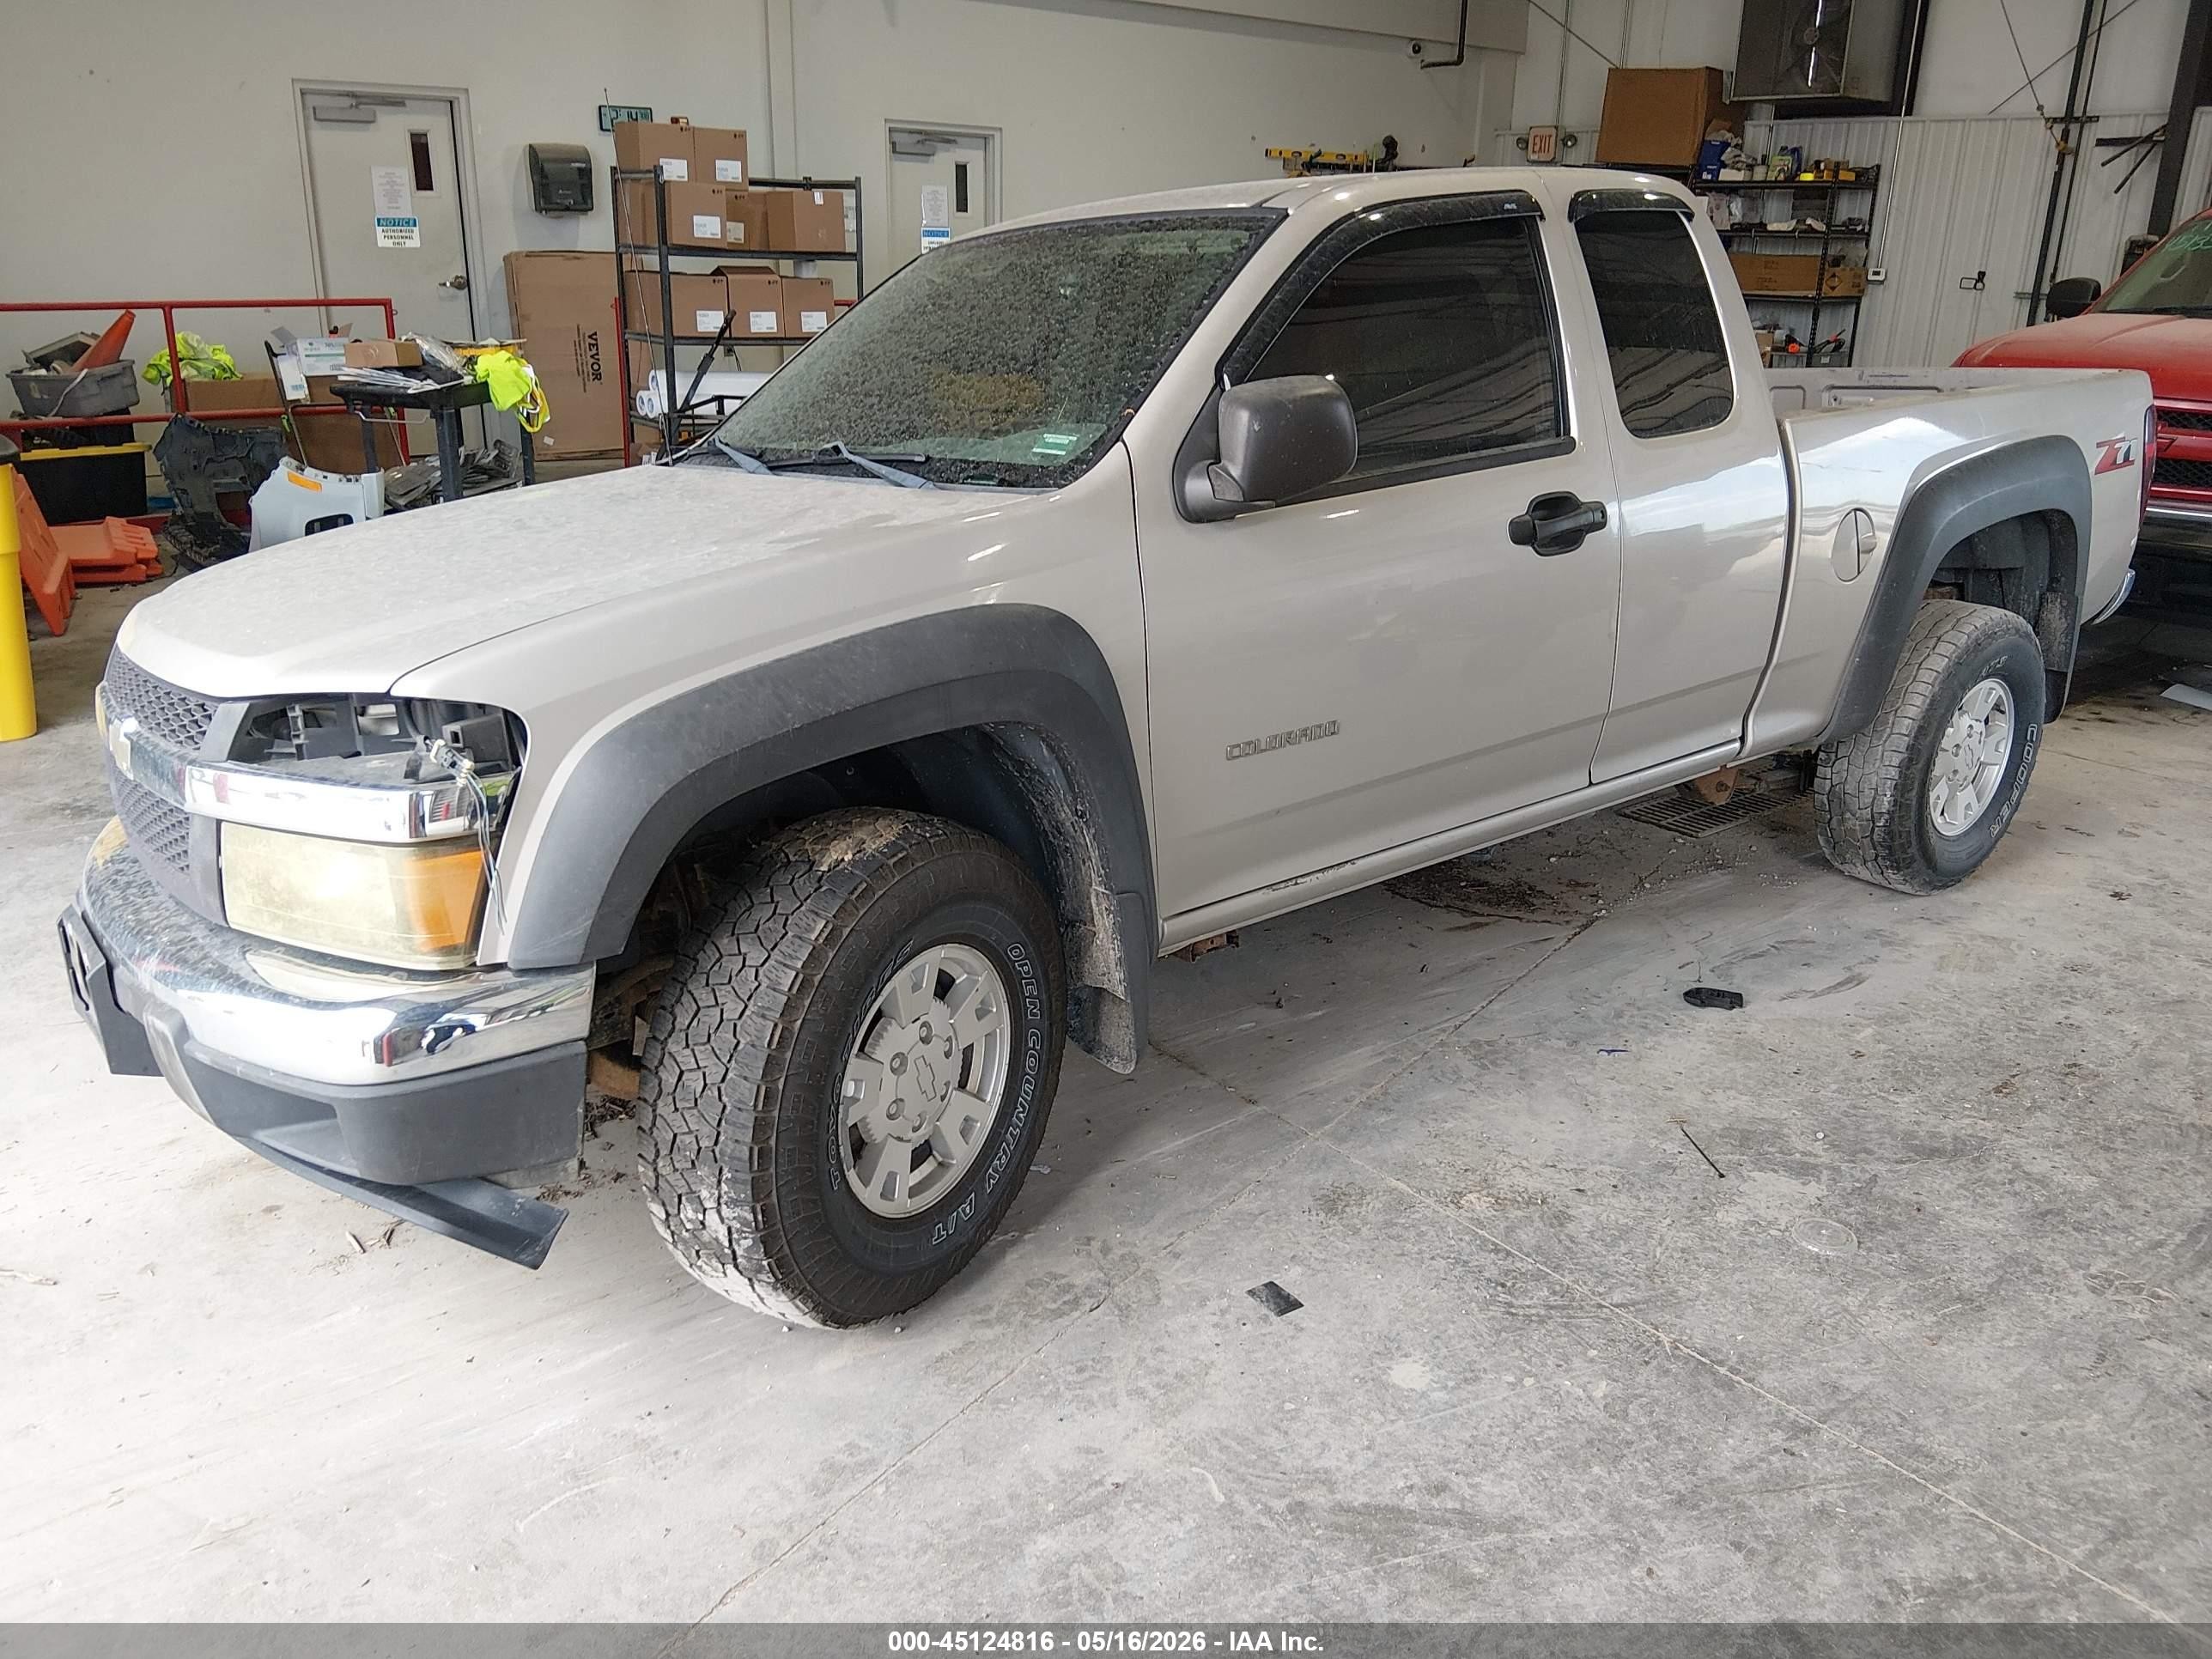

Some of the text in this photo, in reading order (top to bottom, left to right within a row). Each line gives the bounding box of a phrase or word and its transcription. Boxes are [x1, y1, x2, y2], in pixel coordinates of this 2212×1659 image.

[1532, 134, 1553, 154] EXIT
[380, 218, 415, 227] NOTICE
[587, 331, 603, 382] VEVOR
[2094, 436, 2138, 475] Z71
[1225, 720, 1340, 761] COLORADO
[1990, 723, 2038, 839] COOPER
[932, 943, 1042, 1245] OPEN COUNTRY A/T
[829, 1073, 842, 1190] TOYO
